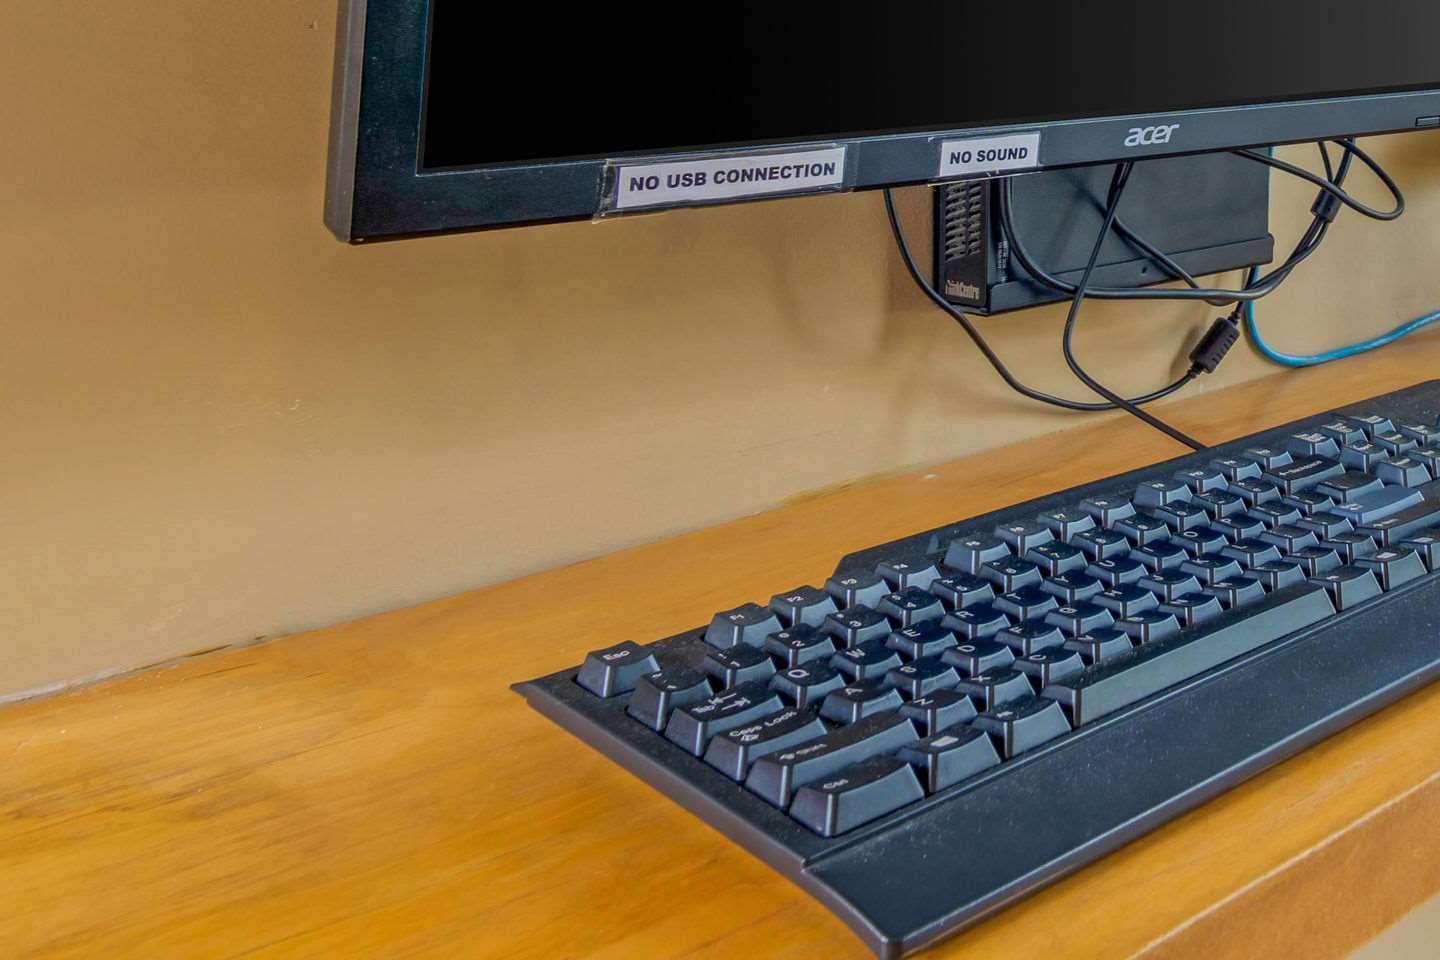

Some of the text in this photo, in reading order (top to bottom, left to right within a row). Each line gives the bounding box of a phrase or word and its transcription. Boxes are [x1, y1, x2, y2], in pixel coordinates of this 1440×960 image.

[1124, 124, 1180, 147] acer
[950, 147, 1028, 164] NO SOUND
[629, 161, 836, 192] NO USB CONNECTION
[902, 628, 921, 639] E
[845, 648, 866, 659] W
[956, 644, 976, 653] D
[602, 649, 631, 661] Esc
[787, 668, 811, 679] Q
